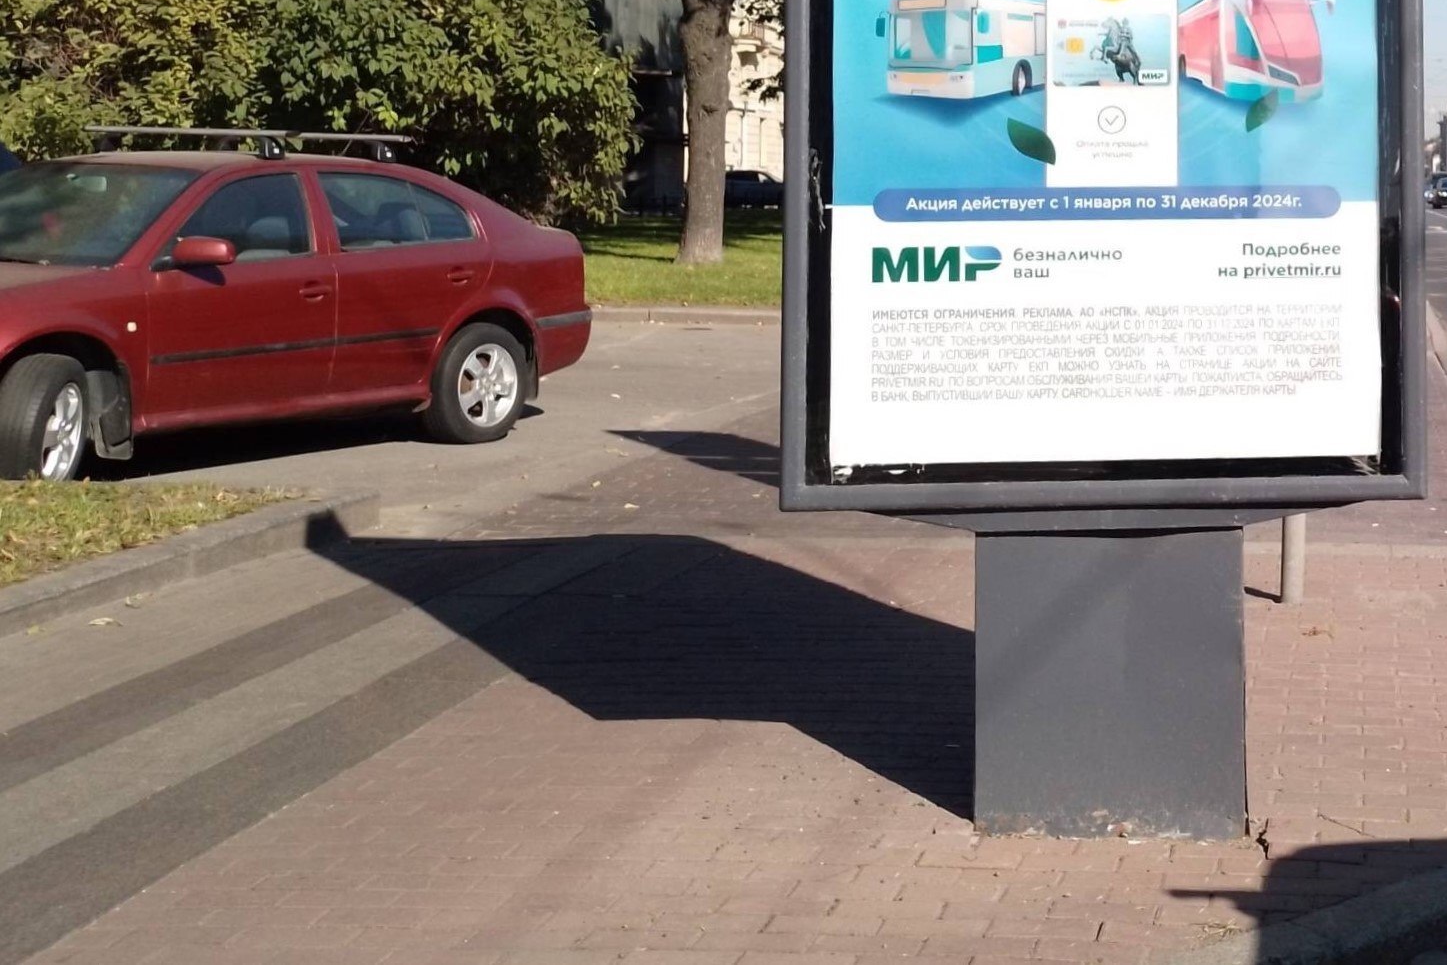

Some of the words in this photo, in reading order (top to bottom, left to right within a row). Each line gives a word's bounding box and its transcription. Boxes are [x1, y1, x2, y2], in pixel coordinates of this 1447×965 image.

[906, 198, 957, 211] Акция
[962, 197, 1045, 211] действует
[1050, 199, 1058, 209] с
[1063, 196, 1068, 208] 1
[1075, 198, 1131, 210] января
[1137, 198, 1156, 208] по
[1162, 195, 1176, 207] 31
[1181, 195, 1247, 209] декабря
[1253, 194, 1301, 207] 2024г.
[1014, 248, 1122, 261] безналично
[1243, 243, 1340, 257] Подробнее
[872, 246, 1002, 282] МИР
[1219, 267, 1237, 276] на
[1244, 263, 1340, 279] privetmir.ru
[1014, 268, 1049, 278] ваш
[872, 309, 928, 321] ИМЕЮТСЯ
[1080, 306, 1094, 317] АО
[1145, 304, 1179, 316] АКЦИЯ
[1188, 317, 1203, 328] ПО
[1076, 333, 1109, 344] ЧЕРЕЗ
[923, 350, 930, 361] И
[1058, 360, 1099, 371] МОЖНО
[1156, 359, 1170, 369] НА
[1286, 356, 1300, 367] НА
